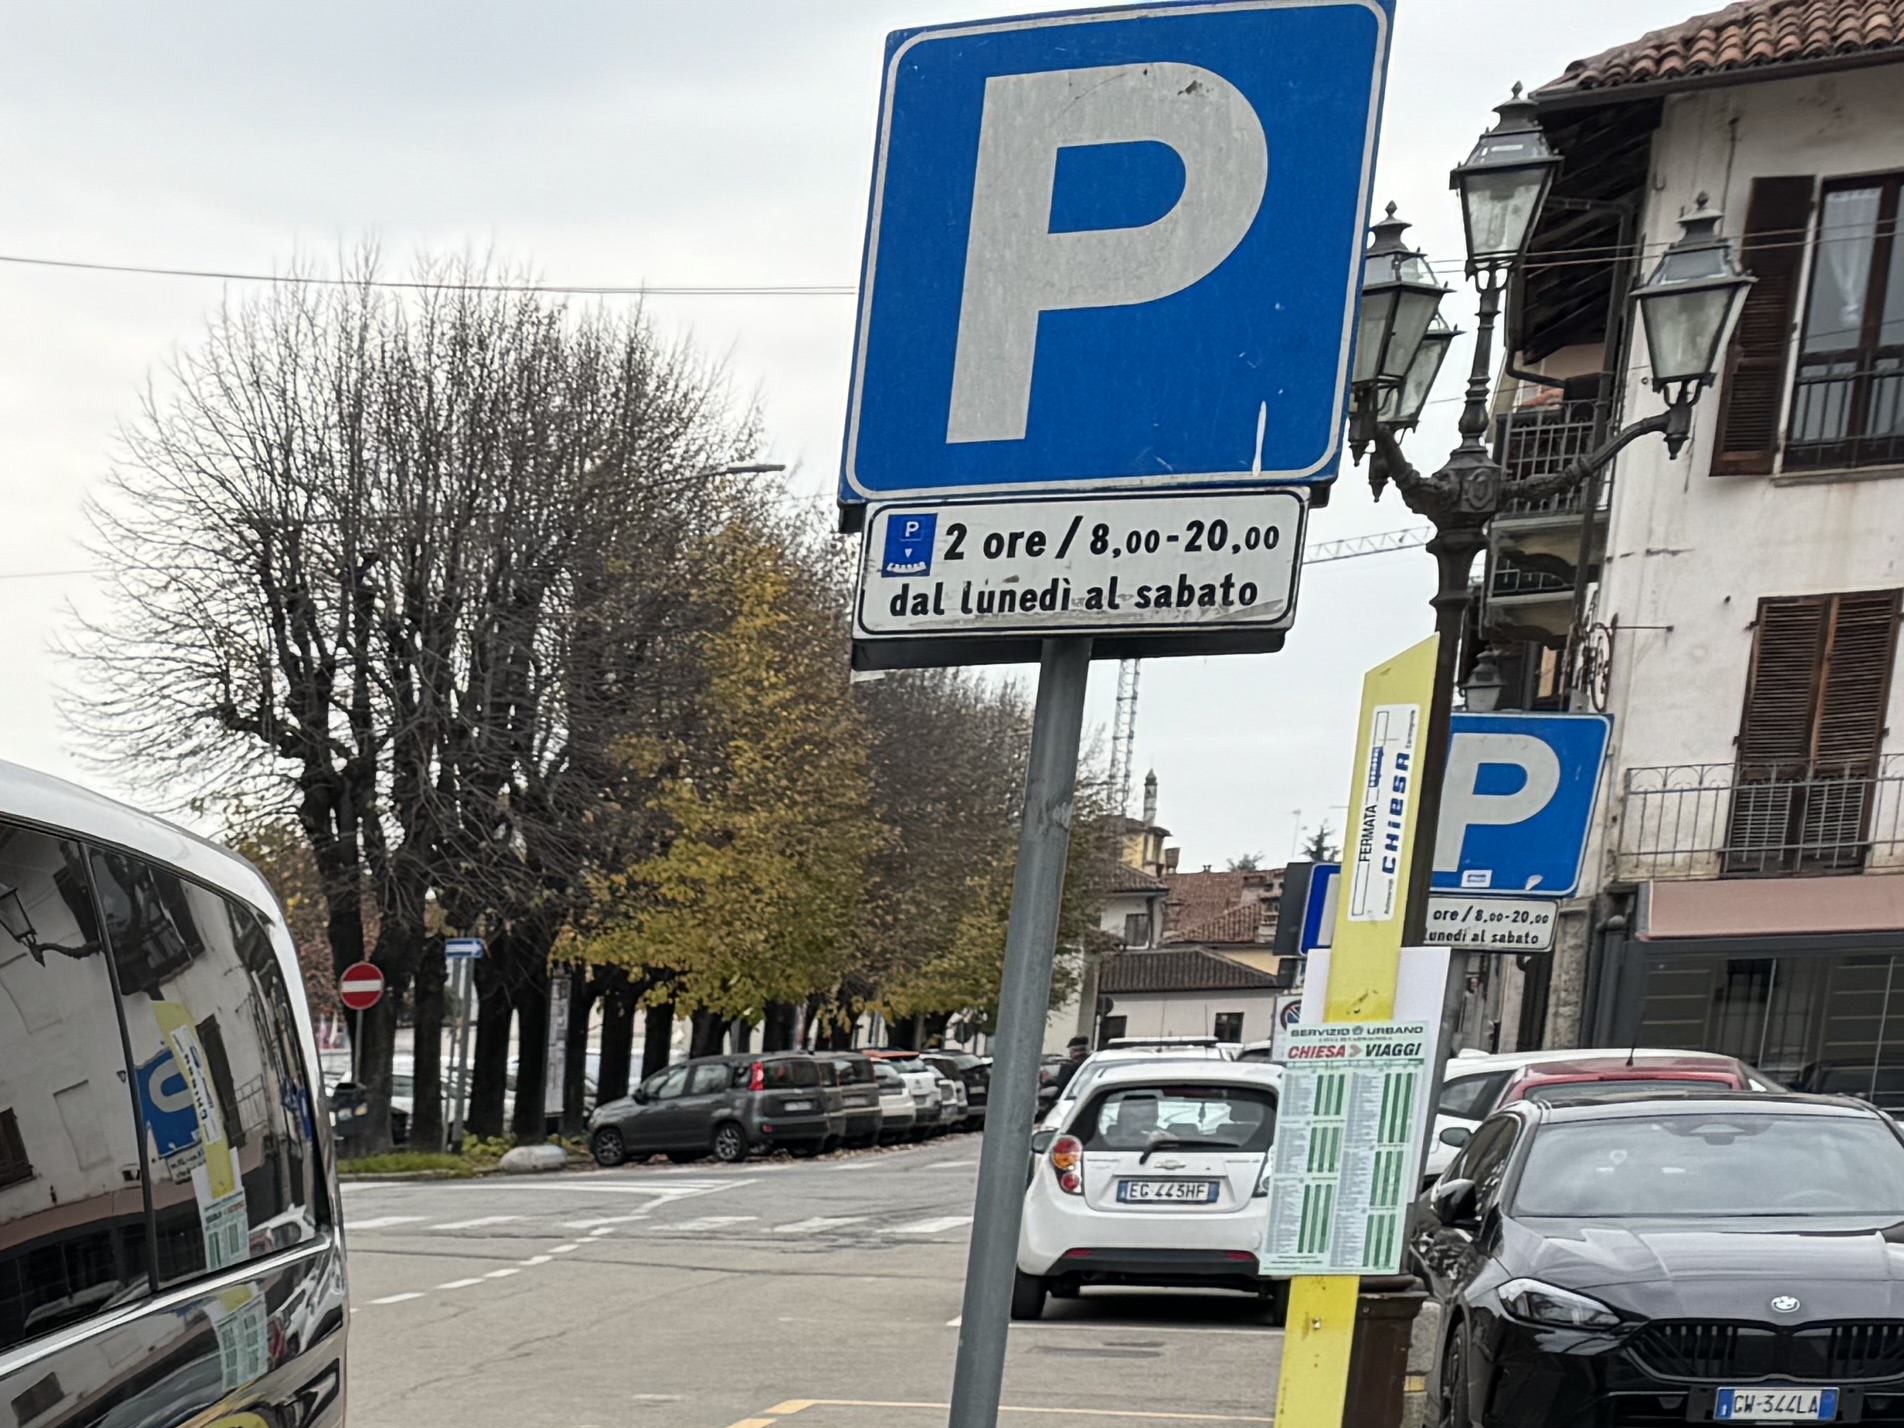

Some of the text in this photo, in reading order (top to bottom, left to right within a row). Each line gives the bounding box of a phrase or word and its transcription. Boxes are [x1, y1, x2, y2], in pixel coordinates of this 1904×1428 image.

[946, 61, 1269, 444] P
[905, 520, 920, 538] P
[943, 522, 967, 561] 2
[982, 528, 1047, 559] ore
[1054, 515, 1084, 560] /
[889, 572, 1259, 617] dal lunedì al sabato
[1432, 732, 1561, 873] P
[1358, 804, 1378, 864] FERMATA
[1433, 909, 1459, 921] ore
[1471, 929, 1486, 943] al
[1491, 930, 1539, 945] sabato
[1287, 1043, 1422, 1059] CHIESA VIAGGI
